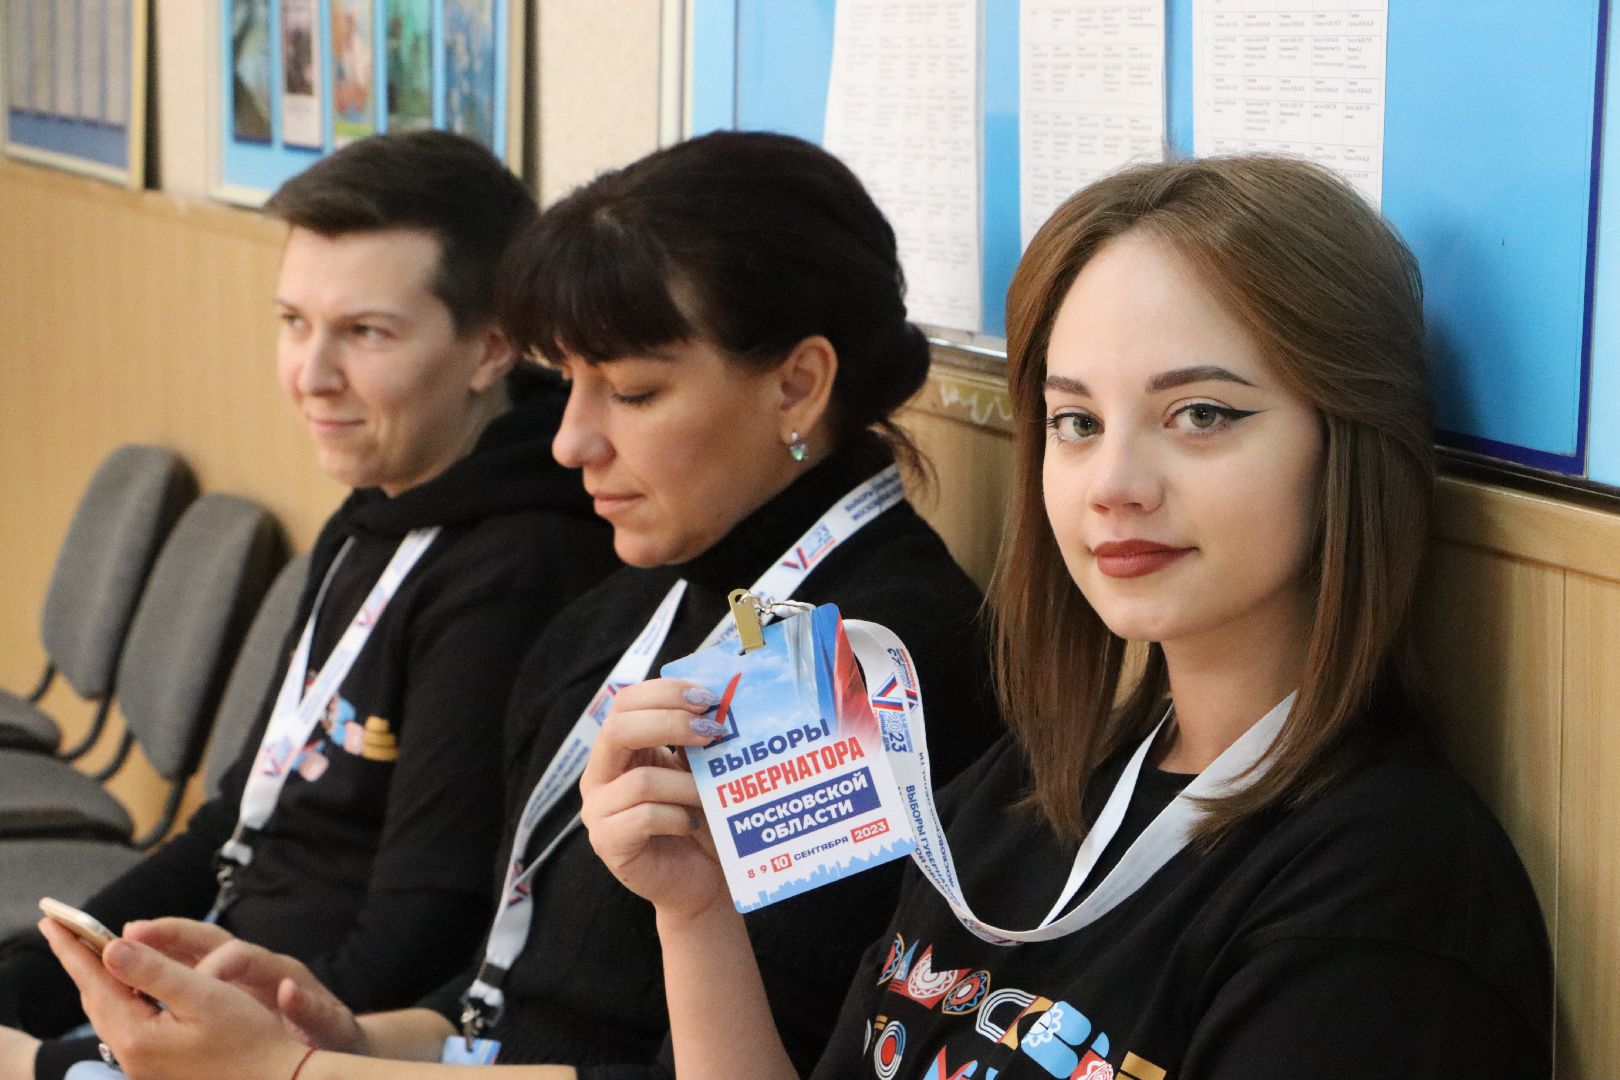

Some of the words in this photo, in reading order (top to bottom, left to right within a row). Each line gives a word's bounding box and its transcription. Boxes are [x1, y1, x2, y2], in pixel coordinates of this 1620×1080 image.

[708, 718, 831, 778] ВЫБОРЫ
[716, 736, 865, 808] ГУБЕРНАТОРА
[733, 771, 868, 834] МОСКОВСКОЙ
[761, 799, 854, 843] ОБЛАСТИ
[906, 784, 926, 837] ВЫБОРЫ
[747, 869, 756, 879] 8
[760, 864, 768, 874] 9
[773, 857, 788, 869] 10
[793, 836, 849, 861] СЕНТЯБРЯ
[854, 822, 887, 841] 2023
